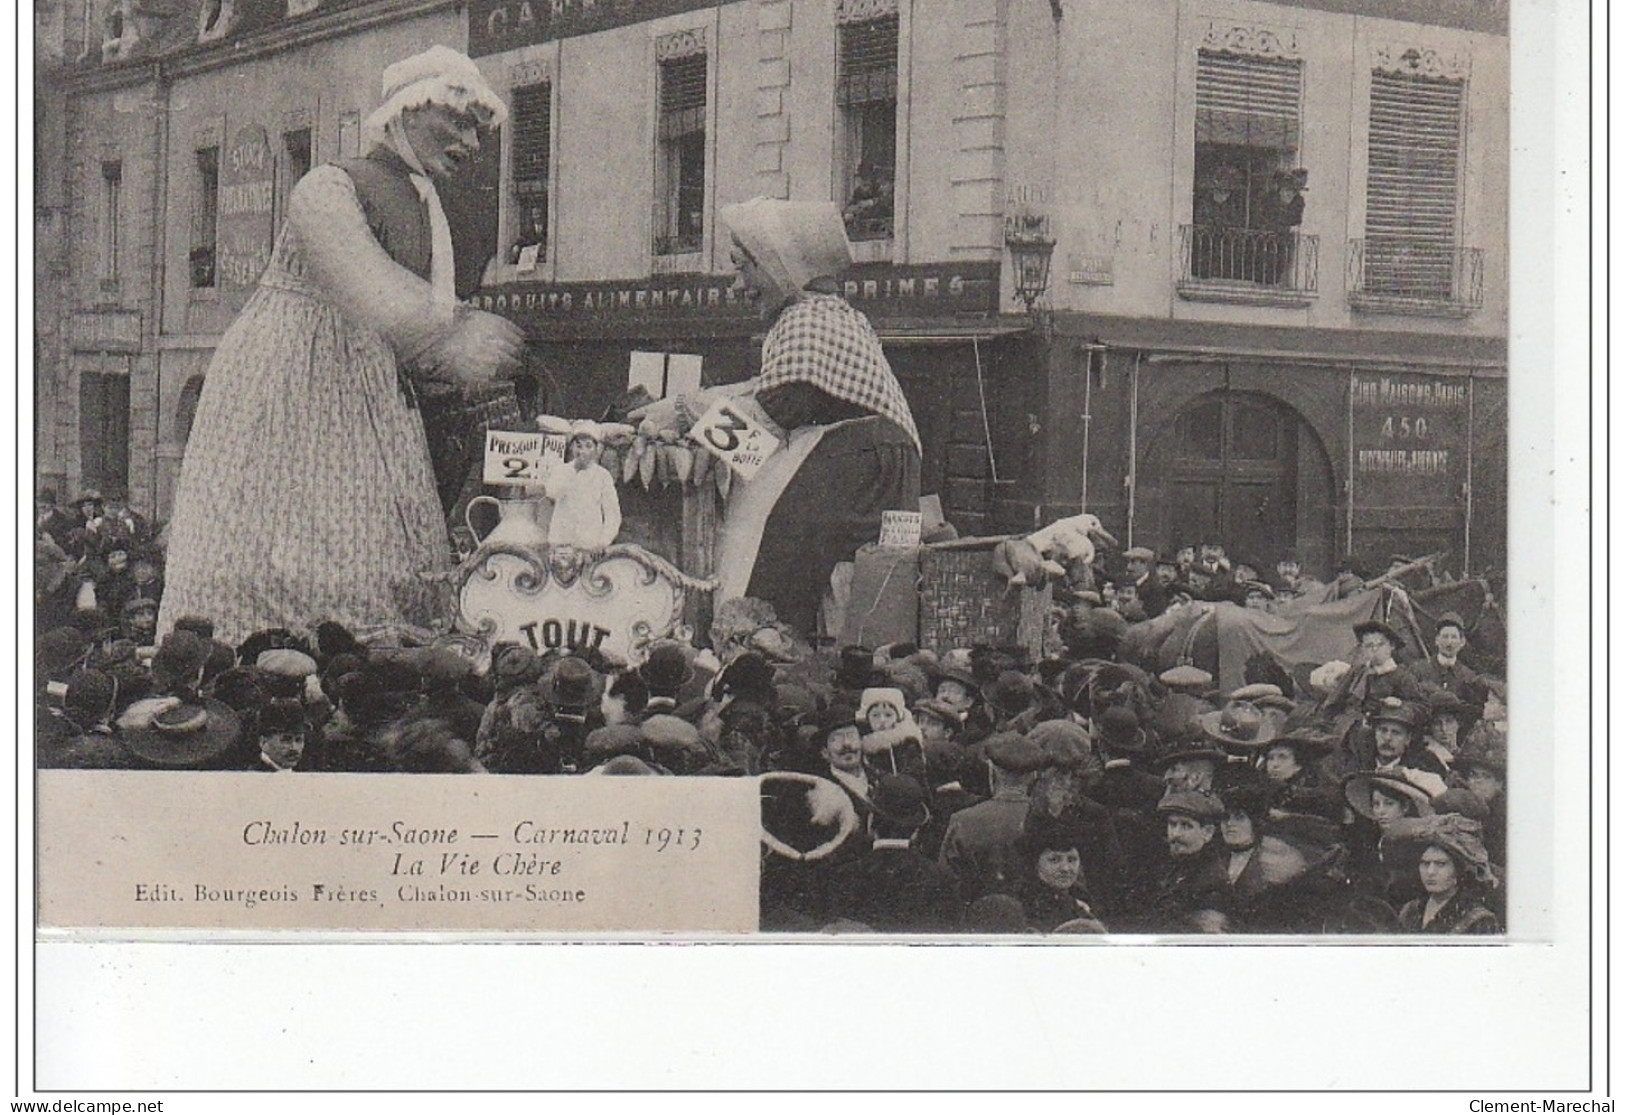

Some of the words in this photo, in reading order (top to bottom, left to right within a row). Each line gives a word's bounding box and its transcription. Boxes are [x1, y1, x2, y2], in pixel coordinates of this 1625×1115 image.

[471, 293, 572, 311] PRODUITS
[844, 276, 964, 299] PRIMES
[704, 407, 748, 451] 3
[503, 457, 531, 479] 2
[519, 618, 611, 652] TOUT
[513, 820, 629, 845] Carnaval
[644, 826, 703, 852] 1913
[391, 853, 424, 876] La
[440, 852, 481, 876] Vie
[493, 852, 562, 876] Chère
[134, 884, 184, 902] Edit.
[194, 884, 298, 909] Bourgeois
